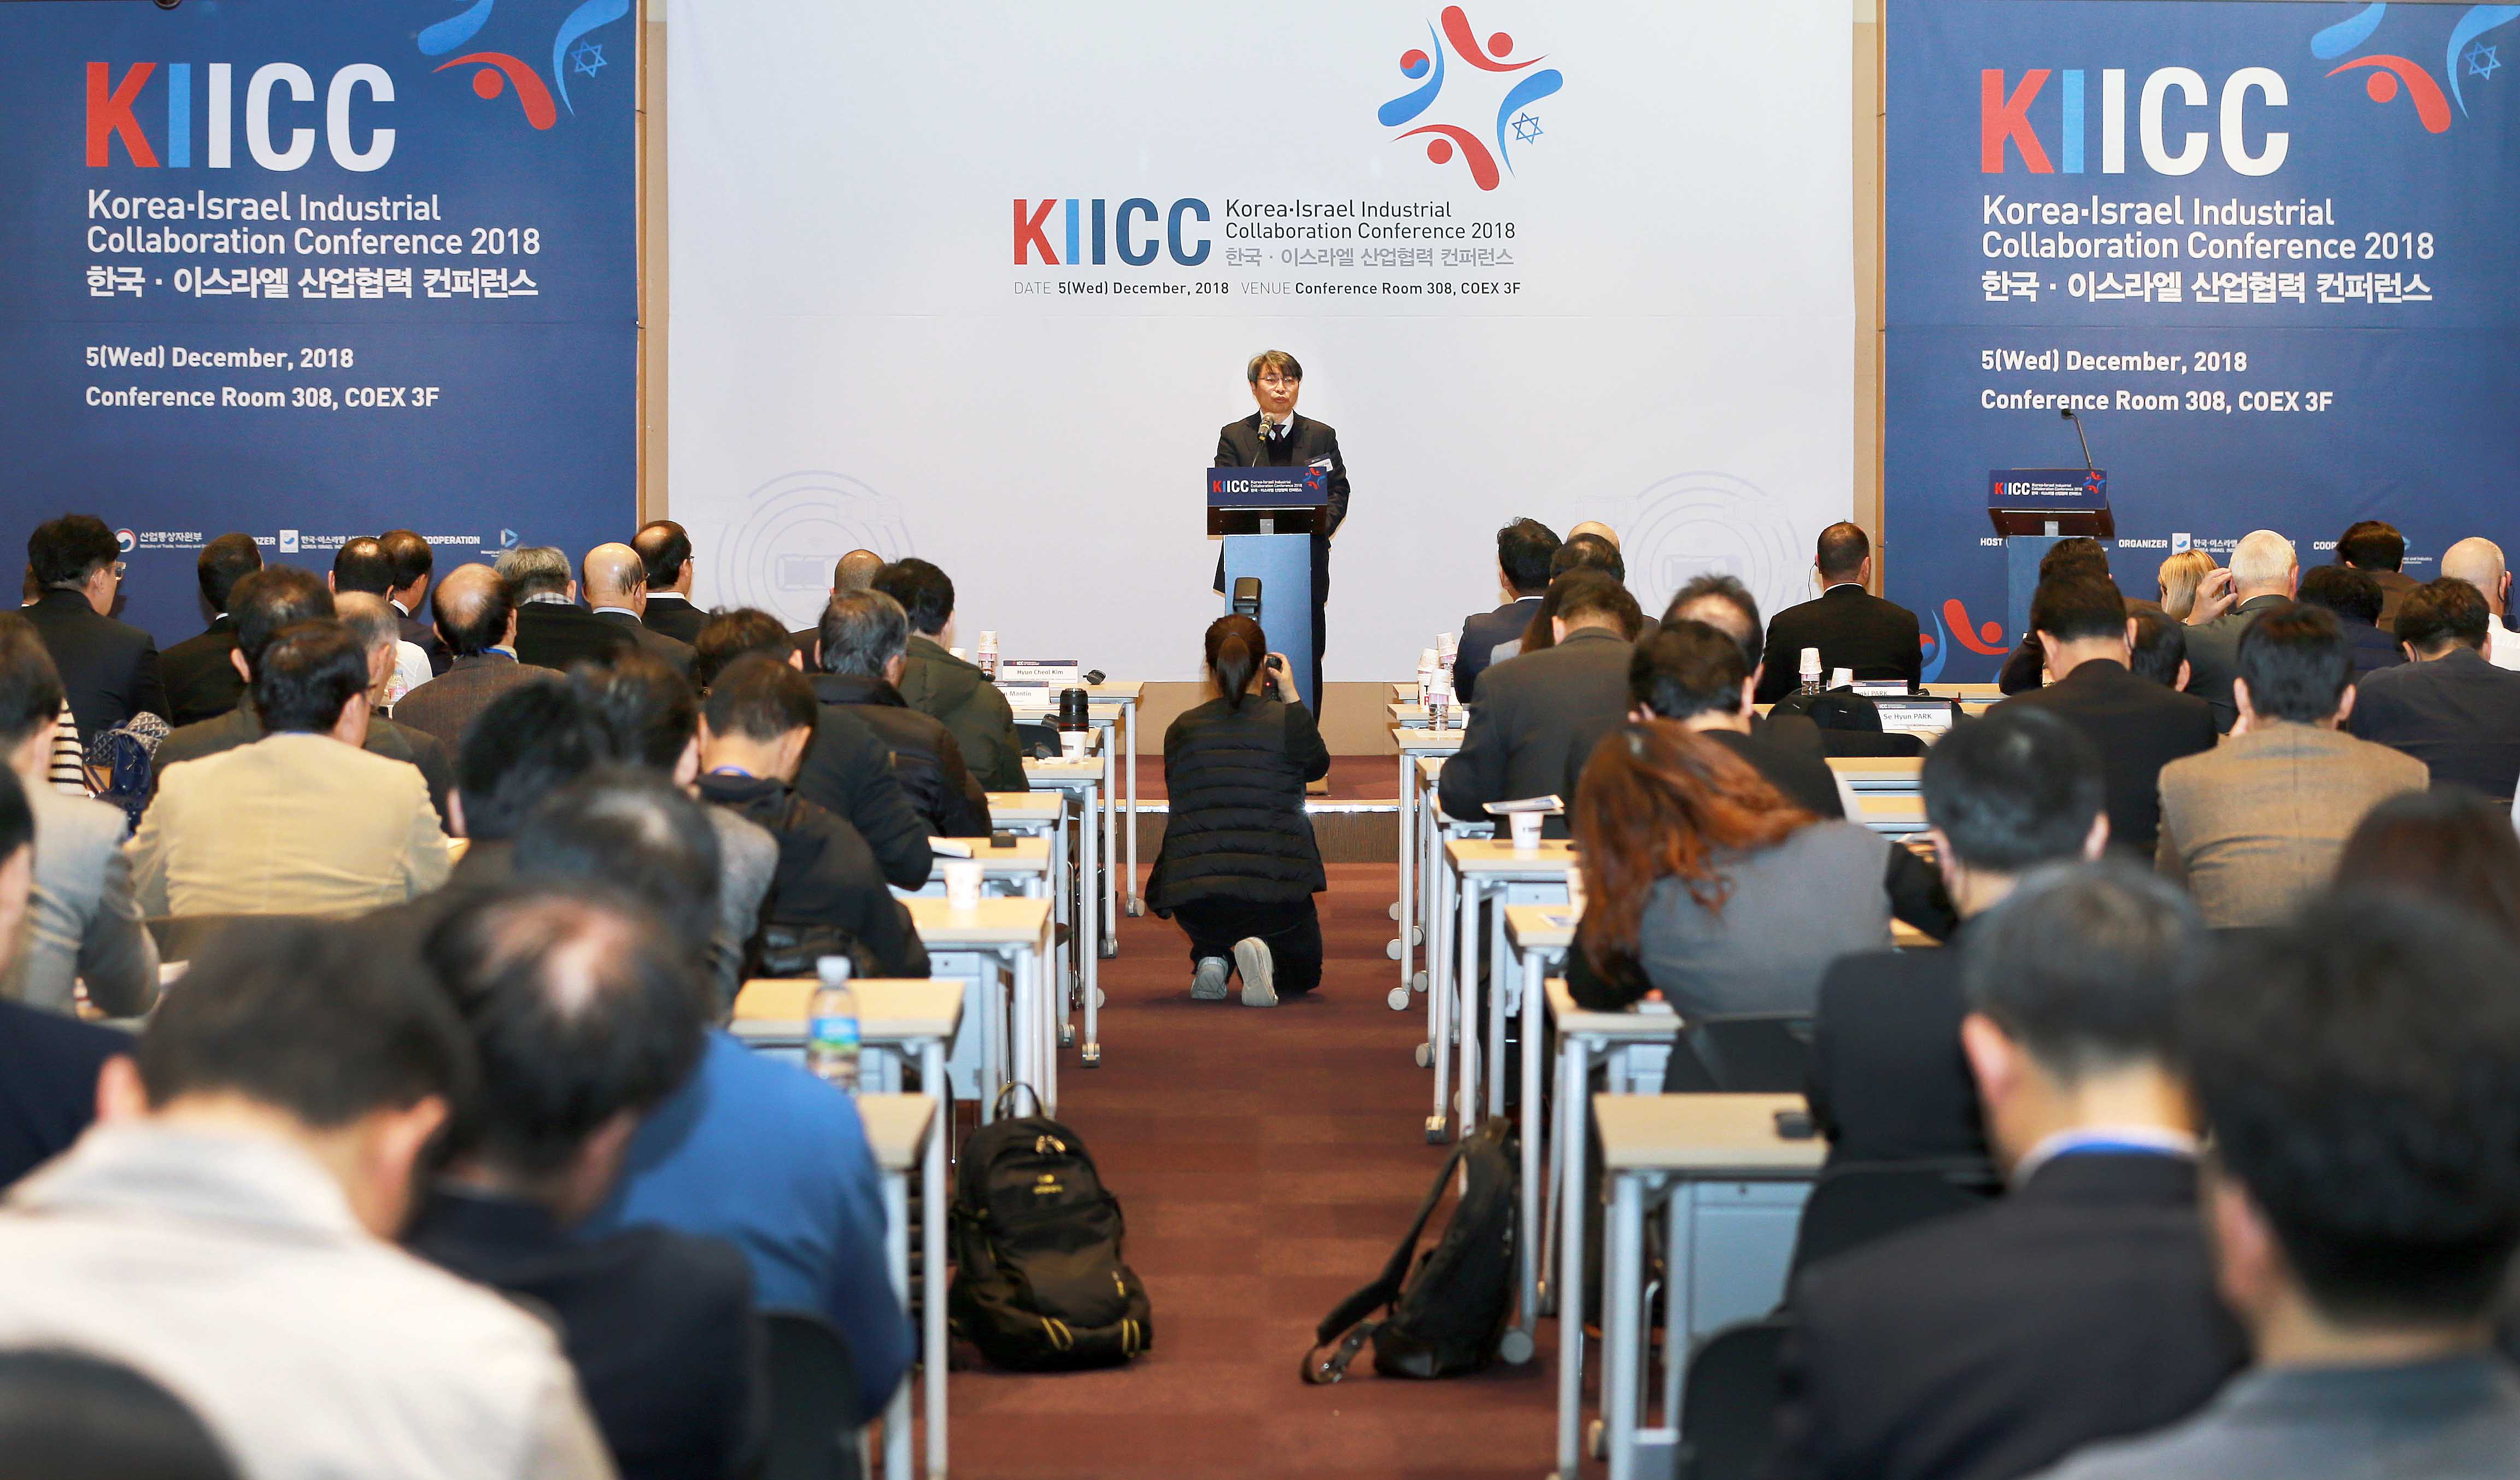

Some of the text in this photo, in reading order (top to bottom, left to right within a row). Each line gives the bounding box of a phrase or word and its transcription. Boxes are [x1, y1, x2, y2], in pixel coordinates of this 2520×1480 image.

[86, 62, 396, 172] KIICC
[1982, 67, 2289, 176] KIICC
[300, 193, 441, 221] Industrial
[1362, 201, 1451, 218] Industrial
[2193, 198, 2335, 226] Industrial
[87, 226, 540, 255] Collaboration Conference 2018
[1014, 198, 1211, 267] KIICC
[1226, 222, 1515, 239] Collaboration Conference 2018
[1226, 248, 1263, 267] 한국
[1281, 248, 1354, 267] 이스라엘
[1360, 248, 1433, 267] 산업협력
[1441, 248, 1514, 267] 컨퍼런스
[1982, 231, 2434, 260] Collaboration Conference 2018
[86, 266, 146, 298] 한국
[174, 266, 289, 298] 이스라엘
[297, 267, 412, 299] 산업협력
[423, 267, 539, 299] 컨퍼런스
[1015, 281, 1521, 297] DATE 5(Wed) December, 2018 VENUE Conference Room 308, COEX 3F
[1981, 271, 2040, 302] 한국
[2068, 271, 2182, 303] 이스라엘
[2190, 271, 2305, 304] 산업협력
[2316, 272, 2433, 304] 컨퍼런스
[86, 345, 354, 372] 5(Wed) December, 2018
[1982, 349, 2247, 375] 5(Wed) December, 2018
[86, 386, 440, 411] Conference Room 308, COEX 3F
[1981, 389, 2334, 415] Conference Room 308, COEX 3F
[1212, 480, 1250, 492] KIICC
[1994, 482, 2030, 496] KIICC
[139, 532, 203, 542] 산업통상자원부
[1980, 538, 2003, 546] HOST
[2118, 539, 2168, 548] ORGANIZER
